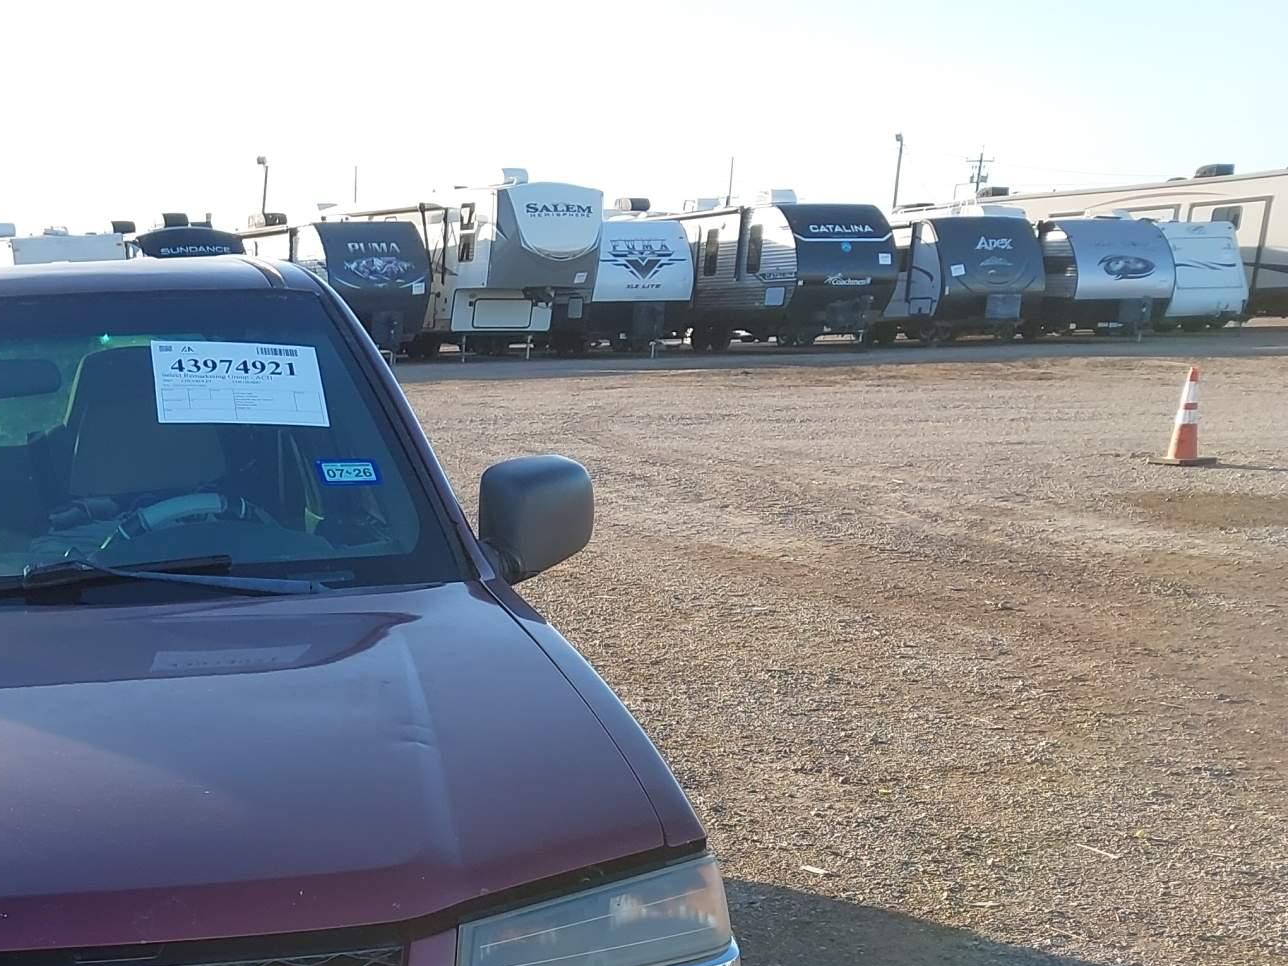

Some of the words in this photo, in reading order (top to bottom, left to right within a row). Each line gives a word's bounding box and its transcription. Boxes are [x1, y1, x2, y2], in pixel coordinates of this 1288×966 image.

[525, 203, 593, 214] SALEM
[809, 224, 874, 233] CATALINA
[347, 242, 401, 254] PUMA
[975, 236, 1014, 250] Apex
[160, 246, 231, 255] SUNDANCE
[170, 358, 298, 377] 43974921
[327, 468, 344, 478] 07
[353, 467, 372, 478] 26
